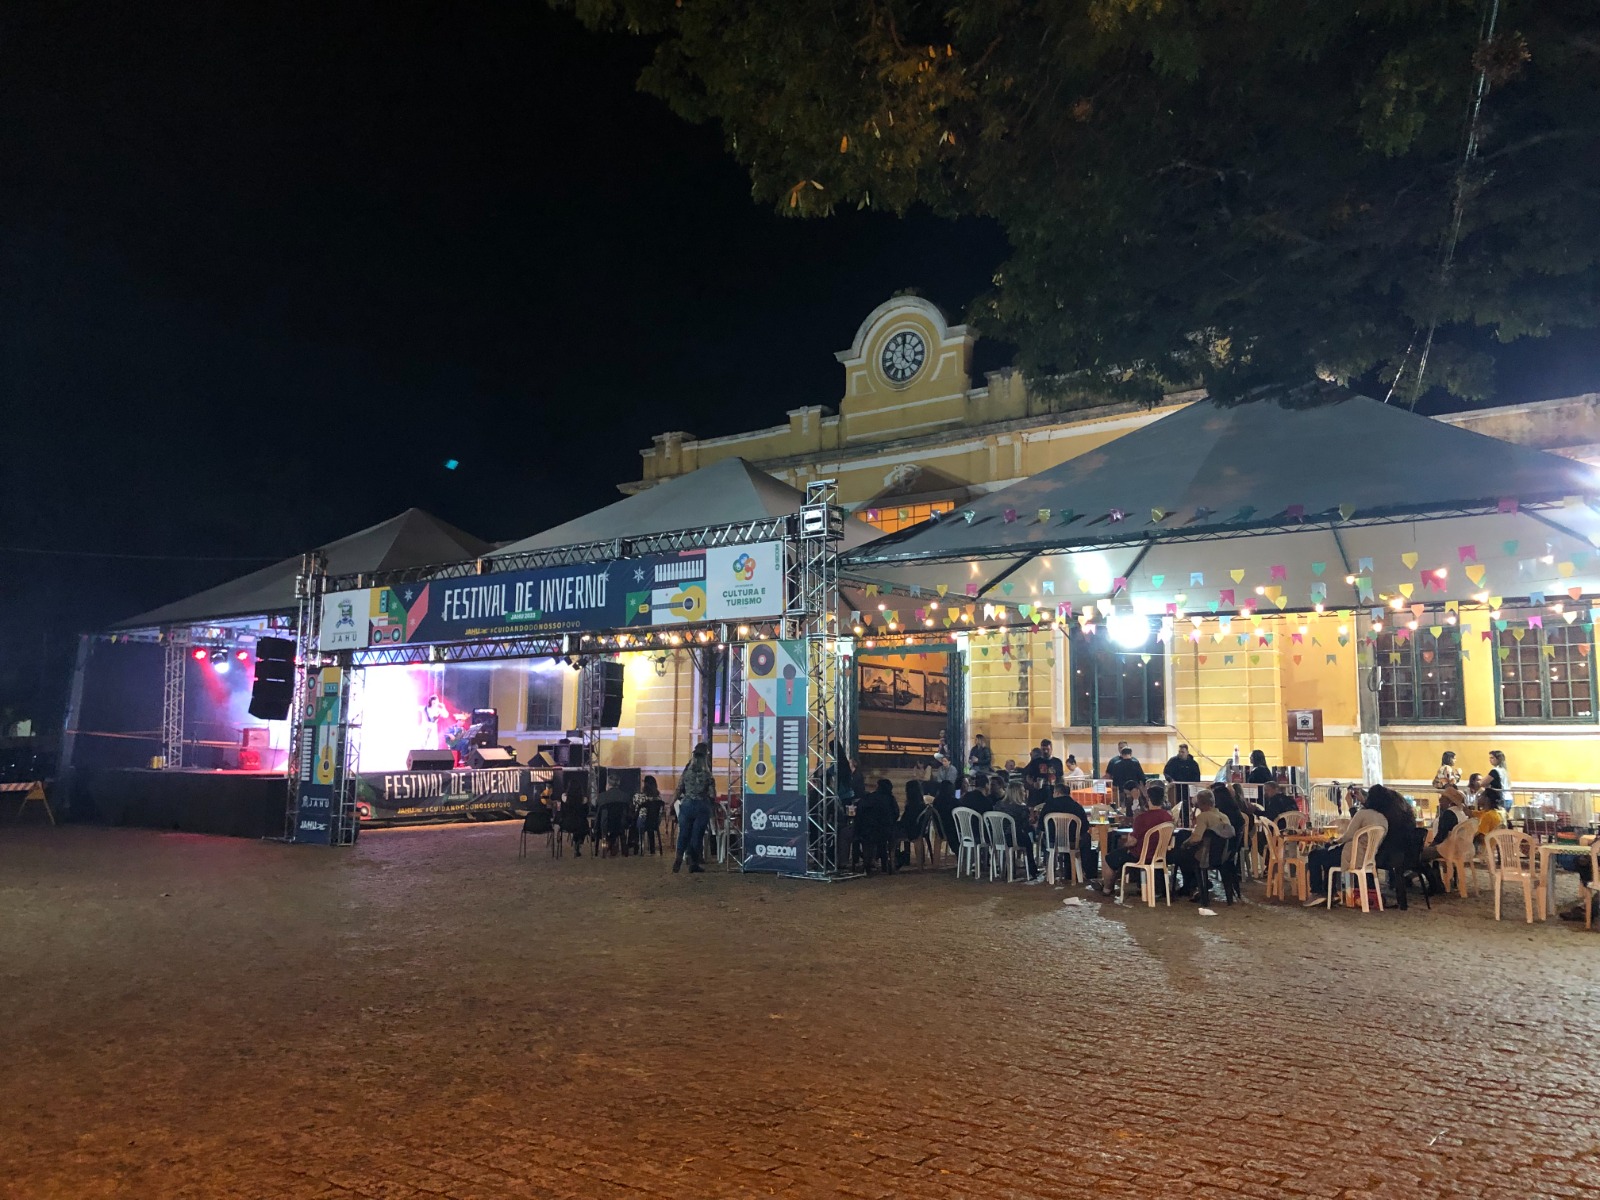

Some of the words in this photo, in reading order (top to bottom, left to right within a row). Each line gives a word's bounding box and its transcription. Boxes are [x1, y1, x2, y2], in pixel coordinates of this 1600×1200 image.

[444, 584, 508, 621] FESTIVAL
[515, 581, 534, 613] DE
[540, 574, 606, 612] INVERNO
[722, 588, 759, 598] CULTURA
[761, 587, 766, 595] E
[726, 597, 762, 606] TURISMO
[332, 633, 357, 644] JAHU
[385, 773, 445, 800] FESTIVAL
[451, 772, 466, 794] DE
[472, 770, 520, 795] INVERNO
[309, 799, 329, 808] JAHU
[768, 814, 795, 822] CULTURA
[766, 845, 796, 856] SECOM
